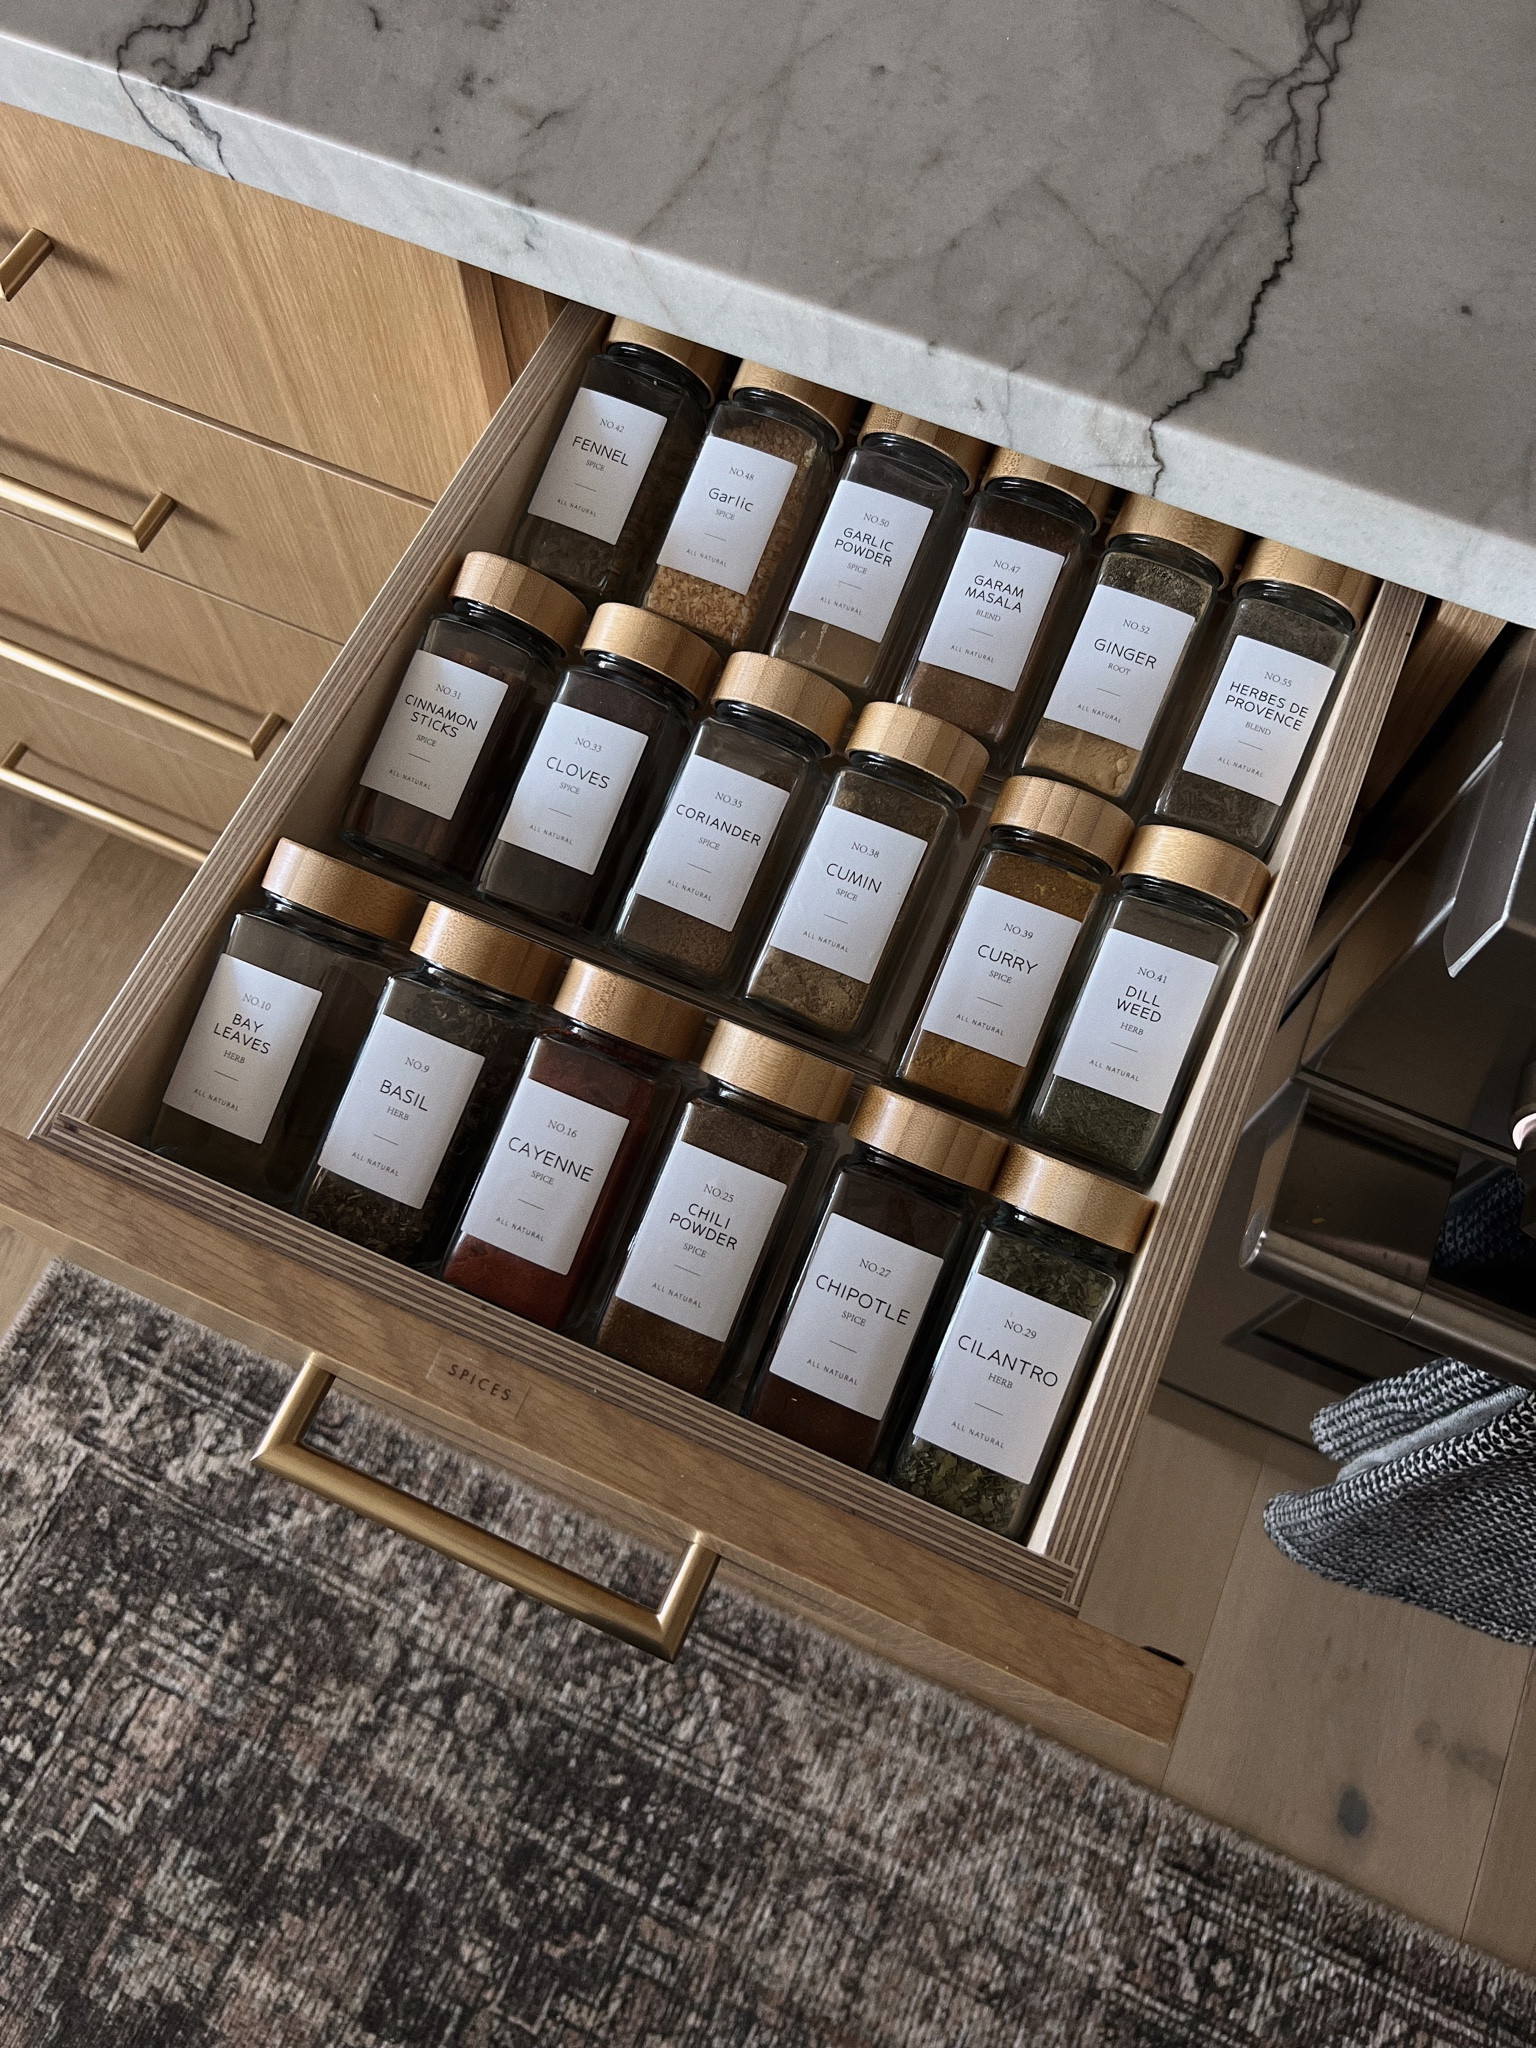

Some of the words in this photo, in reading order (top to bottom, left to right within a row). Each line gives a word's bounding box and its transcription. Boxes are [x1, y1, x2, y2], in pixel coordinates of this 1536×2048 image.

[571, 435, 629, 467] FENNEL
[585, 459, 606, 472] SPICE
[728, 466, 755, 481] NO.48
[556, 498, 567, 507] ALL
[569, 502, 597, 518] NATURAL
[708, 487, 754, 513] Garlic
[715, 508, 735, 521] SPICE
[863, 512, 890, 528] NO.50
[843, 527, 894, 553] GARLIC
[686, 548, 697, 557] ALL
[699, 552, 727, 568] NATURAL
[834, 538, 893, 568] POWDER
[846, 562, 868, 575] SPICE
[992, 559, 1021, 574] NO.47
[973, 574, 1025, 599] GARAM
[819, 596, 831, 605] ALL
[833, 600, 862, 616] NATURAL
[964, 586, 1022, 614] MASALA
[975, 608, 1002, 622] BLEND
[1122, 618, 1151, 635] NO.52
[950, 644, 962, 653] ALL
[964, 648, 994, 664] NATURAL
[1093, 638, 1158, 670] GINGER
[1107, 662, 1132, 676] ROOT
[1263, 671, 1293, 688] NO.55
[434, 683, 462, 700] NO.31
[1229, 680, 1287, 709] HERBES
[1288, 702, 1309, 719] DE
[404, 693, 479, 731] CINNAMON
[1076, 703, 1089, 713] ALL
[1091, 708, 1121, 724] NATURAL
[1224, 694, 1304, 732] PROVENCE
[410, 711, 460, 738] STICKS
[1244, 721, 1272, 736] BLEND
[415, 733, 438, 748] SPICE
[574, 736, 602, 753] NO.33
[546, 756, 611, 789] CLOVES
[1217, 756, 1230, 766] ALL
[1232, 761, 1263, 778] NATURAL
[388, 768, 400, 778] ALL
[402, 773, 431, 791] NATURAL
[559, 781, 581, 795] SPICE
[714, 791, 743, 809] NO.35
[529, 824, 541, 833] ALL
[543, 829, 573, 846] NATURAL
[675, 803, 762, 847] CORIANDER
[697, 836, 721, 851] SPICE
[850, 841, 880, 859] NO.38
[826, 862, 883, 894] CUMIN
[667, 879, 679, 889] ALL
[681, 884, 712, 902] NATURAL
[835, 887, 859, 902] SPICE
[802, 930, 815, 940] ALL
[817, 936, 848, 953] NATURAL
[1003, 922, 1034, 940] NO.39
[977, 944, 1039, 975] CURRY
[988, 969, 1013, 984] SPICE
[1136, 966, 1168, 984] NO.41
[242, 993, 272, 1011] NO.10
[1125, 985, 1161, 1008] DILL
[1116, 997, 1162, 1023] WEED
[231, 1012, 264, 1034] BAY
[955, 1013, 969, 1023] ALL
[971, 1019, 1004, 1037] NATURAL
[1119, 1021, 1144, 1036] HERB
[213, 1022, 272, 1055] LEAVES
[223, 1049, 246, 1064] HERB
[404, 1056, 430, 1074] NO.9
[1088, 1059, 1103, 1069] ALL
[1105, 1064, 1139, 1082] NATURAL
[193, 1088, 206, 1098] ALL
[207, 1093, 239, 1112] NATURAL
[379, 1079, 428, 1112] BASIL
[386, 1105, 410, 1121] HERB
[547, 1119, 578, 1139] NO.16
[351, 1151, 364, 1162] ALL
[366, 1157, 399, 1177] NATURAL
[508, 1136, 594, 1183] CAYENNE
[530, 1170, 555, 1186] SPICE
[703, 1183, 735, 1203] NO.25
[687, 1202, 731, 1230] CHILI
[495, 1216, 509, 1227] ALL
[511, 1223, 544, 1242] NATURAL
[668, 1212, 738, 1251] POWDER
[682, 1242, 708, 1259] SPICE
[858, 1257, 892, 1278] NO.27
[651, 1282, 665, 1293] ALL
[667, 1288, 702, 1309] NATURAL
[815, 1274, 911, 1326] CHIPOTLE
[840, 1310, 867, 1327] SPICE
[1003, 1318, 1038, 1340] NO.29
[806, 1358, 820, 1369] ALL
[823, 1365, 858, 1386] NATURAL
[957, 1334, 1059, 1388] CILANTRO
[447, 1363, 512, 1401] SPICES
[987, 1372, 1014, 1389] HERB
[951, 1421, 965, 1433] ALL
[968, 1428, 1004, 1449] NATURAL
